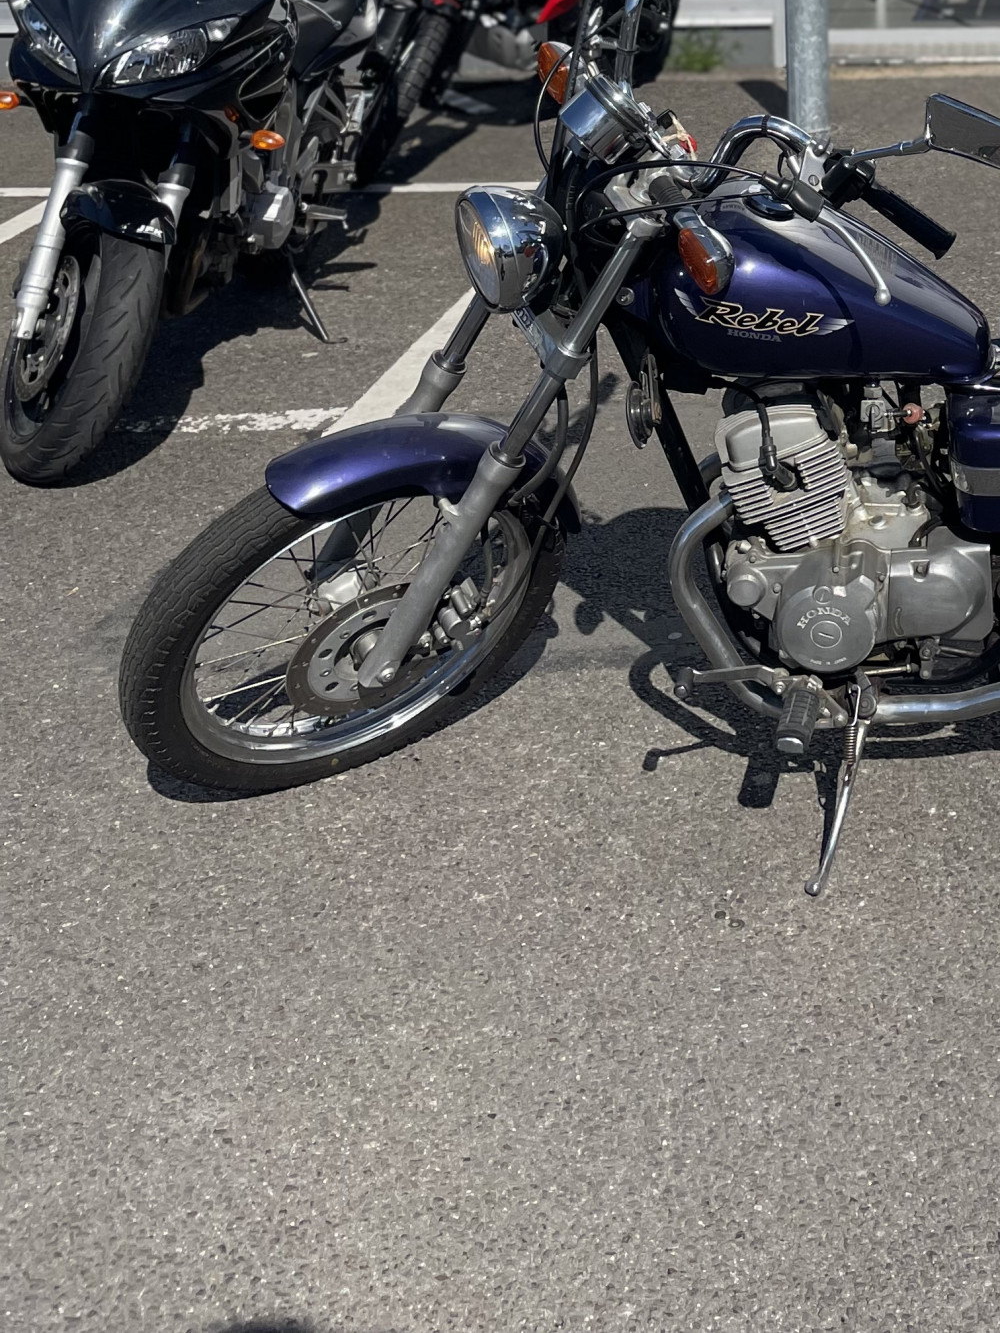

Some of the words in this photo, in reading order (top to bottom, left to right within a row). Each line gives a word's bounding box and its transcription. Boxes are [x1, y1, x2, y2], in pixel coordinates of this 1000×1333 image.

[695, 296, 824, 337] Rebel
[726, 328, 782, 342] HONDA
[796, 606, 851, 629] HONDA
